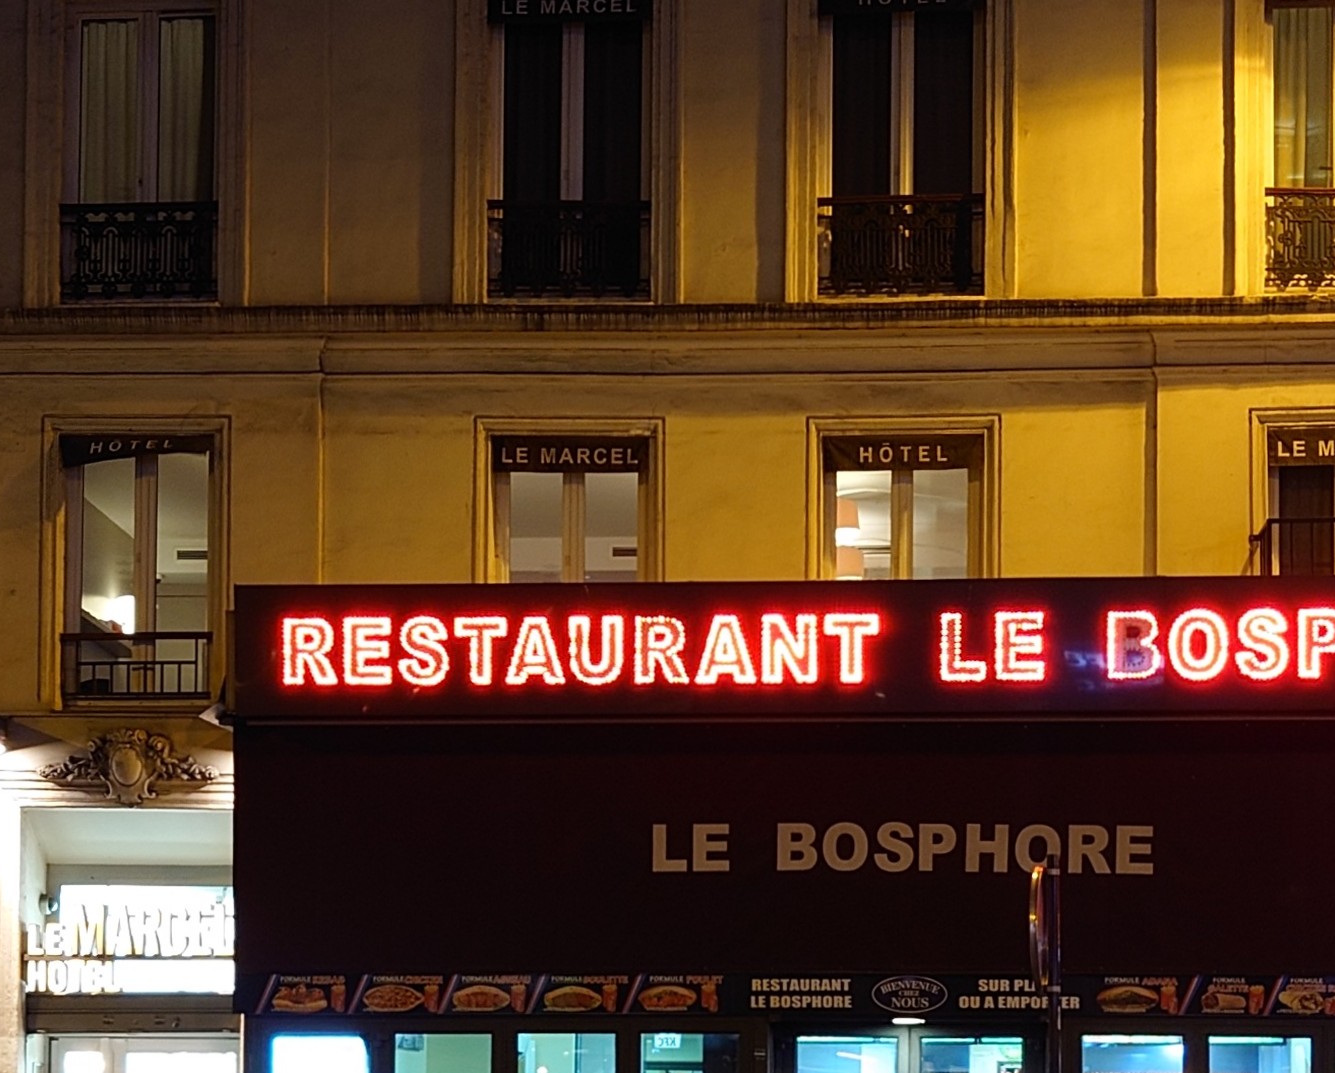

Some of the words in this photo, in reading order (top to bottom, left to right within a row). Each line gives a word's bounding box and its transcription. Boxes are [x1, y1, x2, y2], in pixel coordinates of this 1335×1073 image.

[501, 0, 529, 15] LE
[540, 0, 638, 14] MARCEL
[501, 447, 529, 464] LE
[540, 447, 640, 464] MARCEL
[859, 442, 949, 463] HÔTEL
[1276, 440, 1306, 458] LE
[279, 610, 881, 688] RESTAURANT
[937, 609, 1048, 684] LE
[651, 823, 731, 873] LE
[776, 821, 1155, 875] BOSPHORE
[27, 922, 63, 956] LE
[649, 975, 684, 983] FORMULE
[751, 978, 852, 992] RESTAURANT
[977, 979, 1011, 993] SUR
[880, 980, 940, 995] BIENVENUE
[750, 995, 766, 1009] LE
[769, 995, 852, 1009] BOSPHORE
[891, 997, 930, 1008] NOUS
[958, 995, 980, 1009] OU
[983, 996, 995, 1009] A
